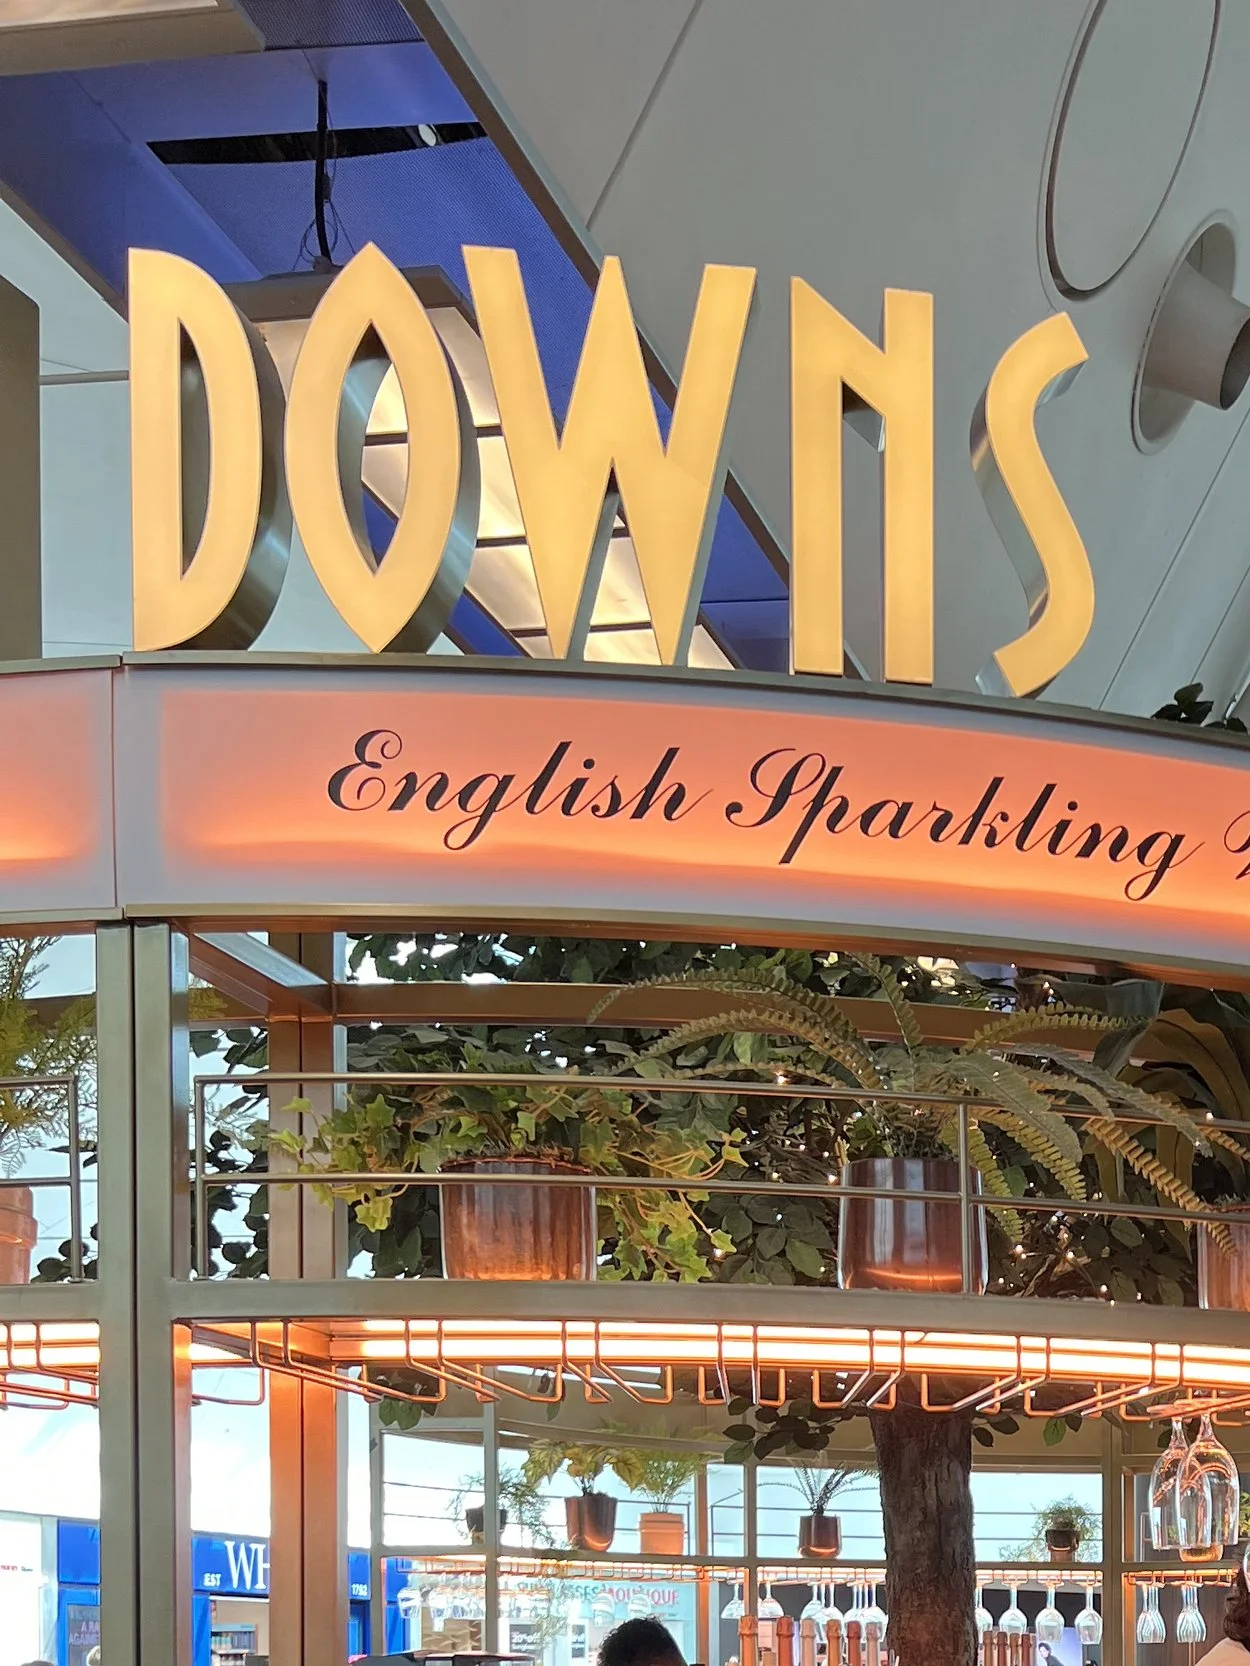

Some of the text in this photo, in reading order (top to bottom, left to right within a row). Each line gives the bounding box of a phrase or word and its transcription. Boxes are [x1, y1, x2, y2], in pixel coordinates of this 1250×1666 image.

[128, 241, 1096, 697] DOWNS
[327, 729, 716, 851] English
[724, 746, 1205, 902] Sparkling
[203, 1572, 222, 1587] EST
